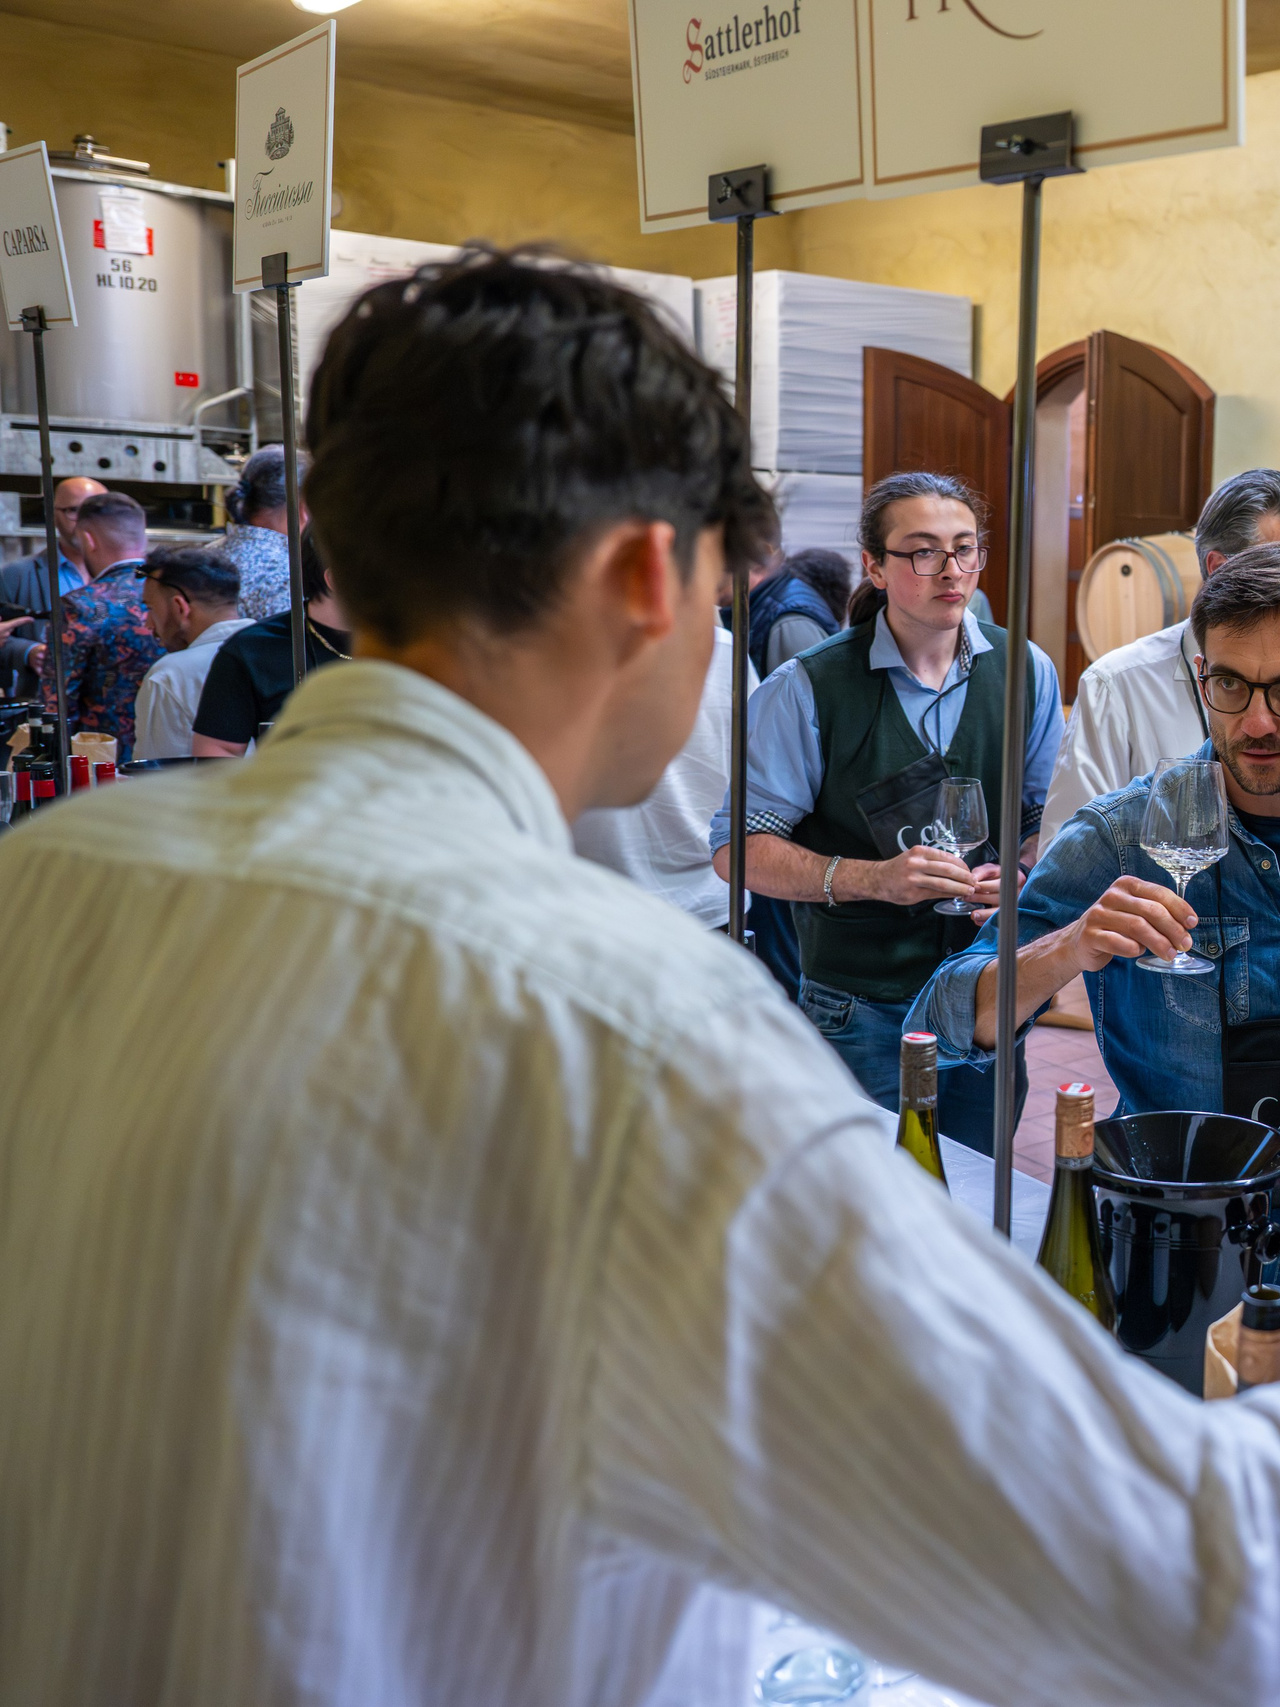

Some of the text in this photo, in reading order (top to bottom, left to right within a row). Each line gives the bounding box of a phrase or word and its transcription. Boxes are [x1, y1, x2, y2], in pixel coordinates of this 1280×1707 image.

[683, 0, 801, 84] Sattlerhof
[3, 225, 50, 257] CAPARSA
[110, 258, 132, 272] 56
[97, 273, 116, 288] HL
